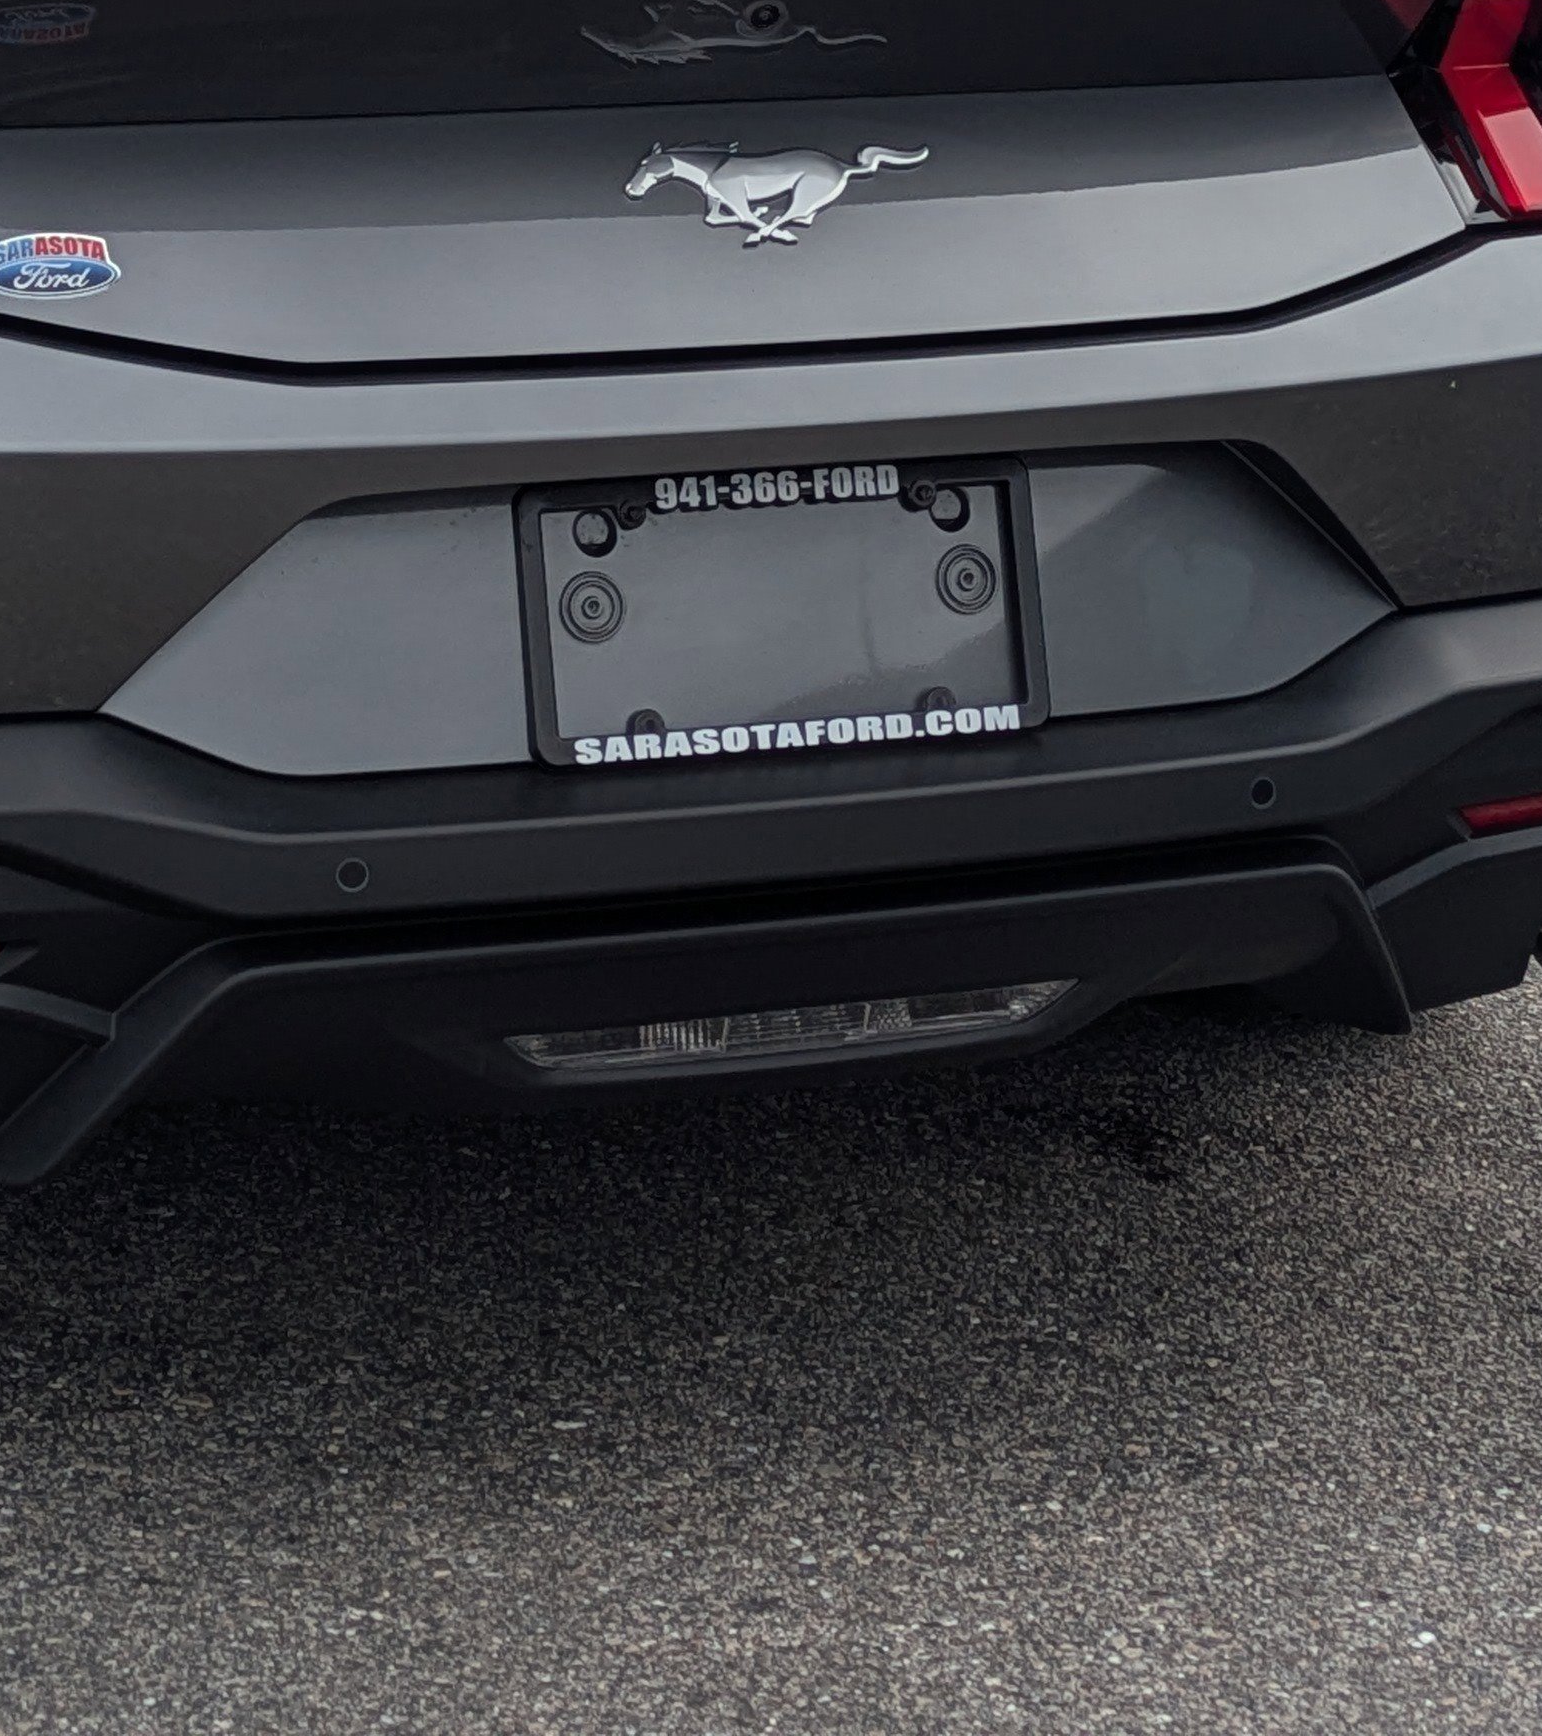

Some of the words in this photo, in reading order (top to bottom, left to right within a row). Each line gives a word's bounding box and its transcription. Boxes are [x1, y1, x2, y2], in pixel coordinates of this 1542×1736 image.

[13, 262, 91, 290] Ford
[654, 464, 900, 510] 941-366-FORD
[574, 704, 1021, 765] SARASOTAFORD.COM
